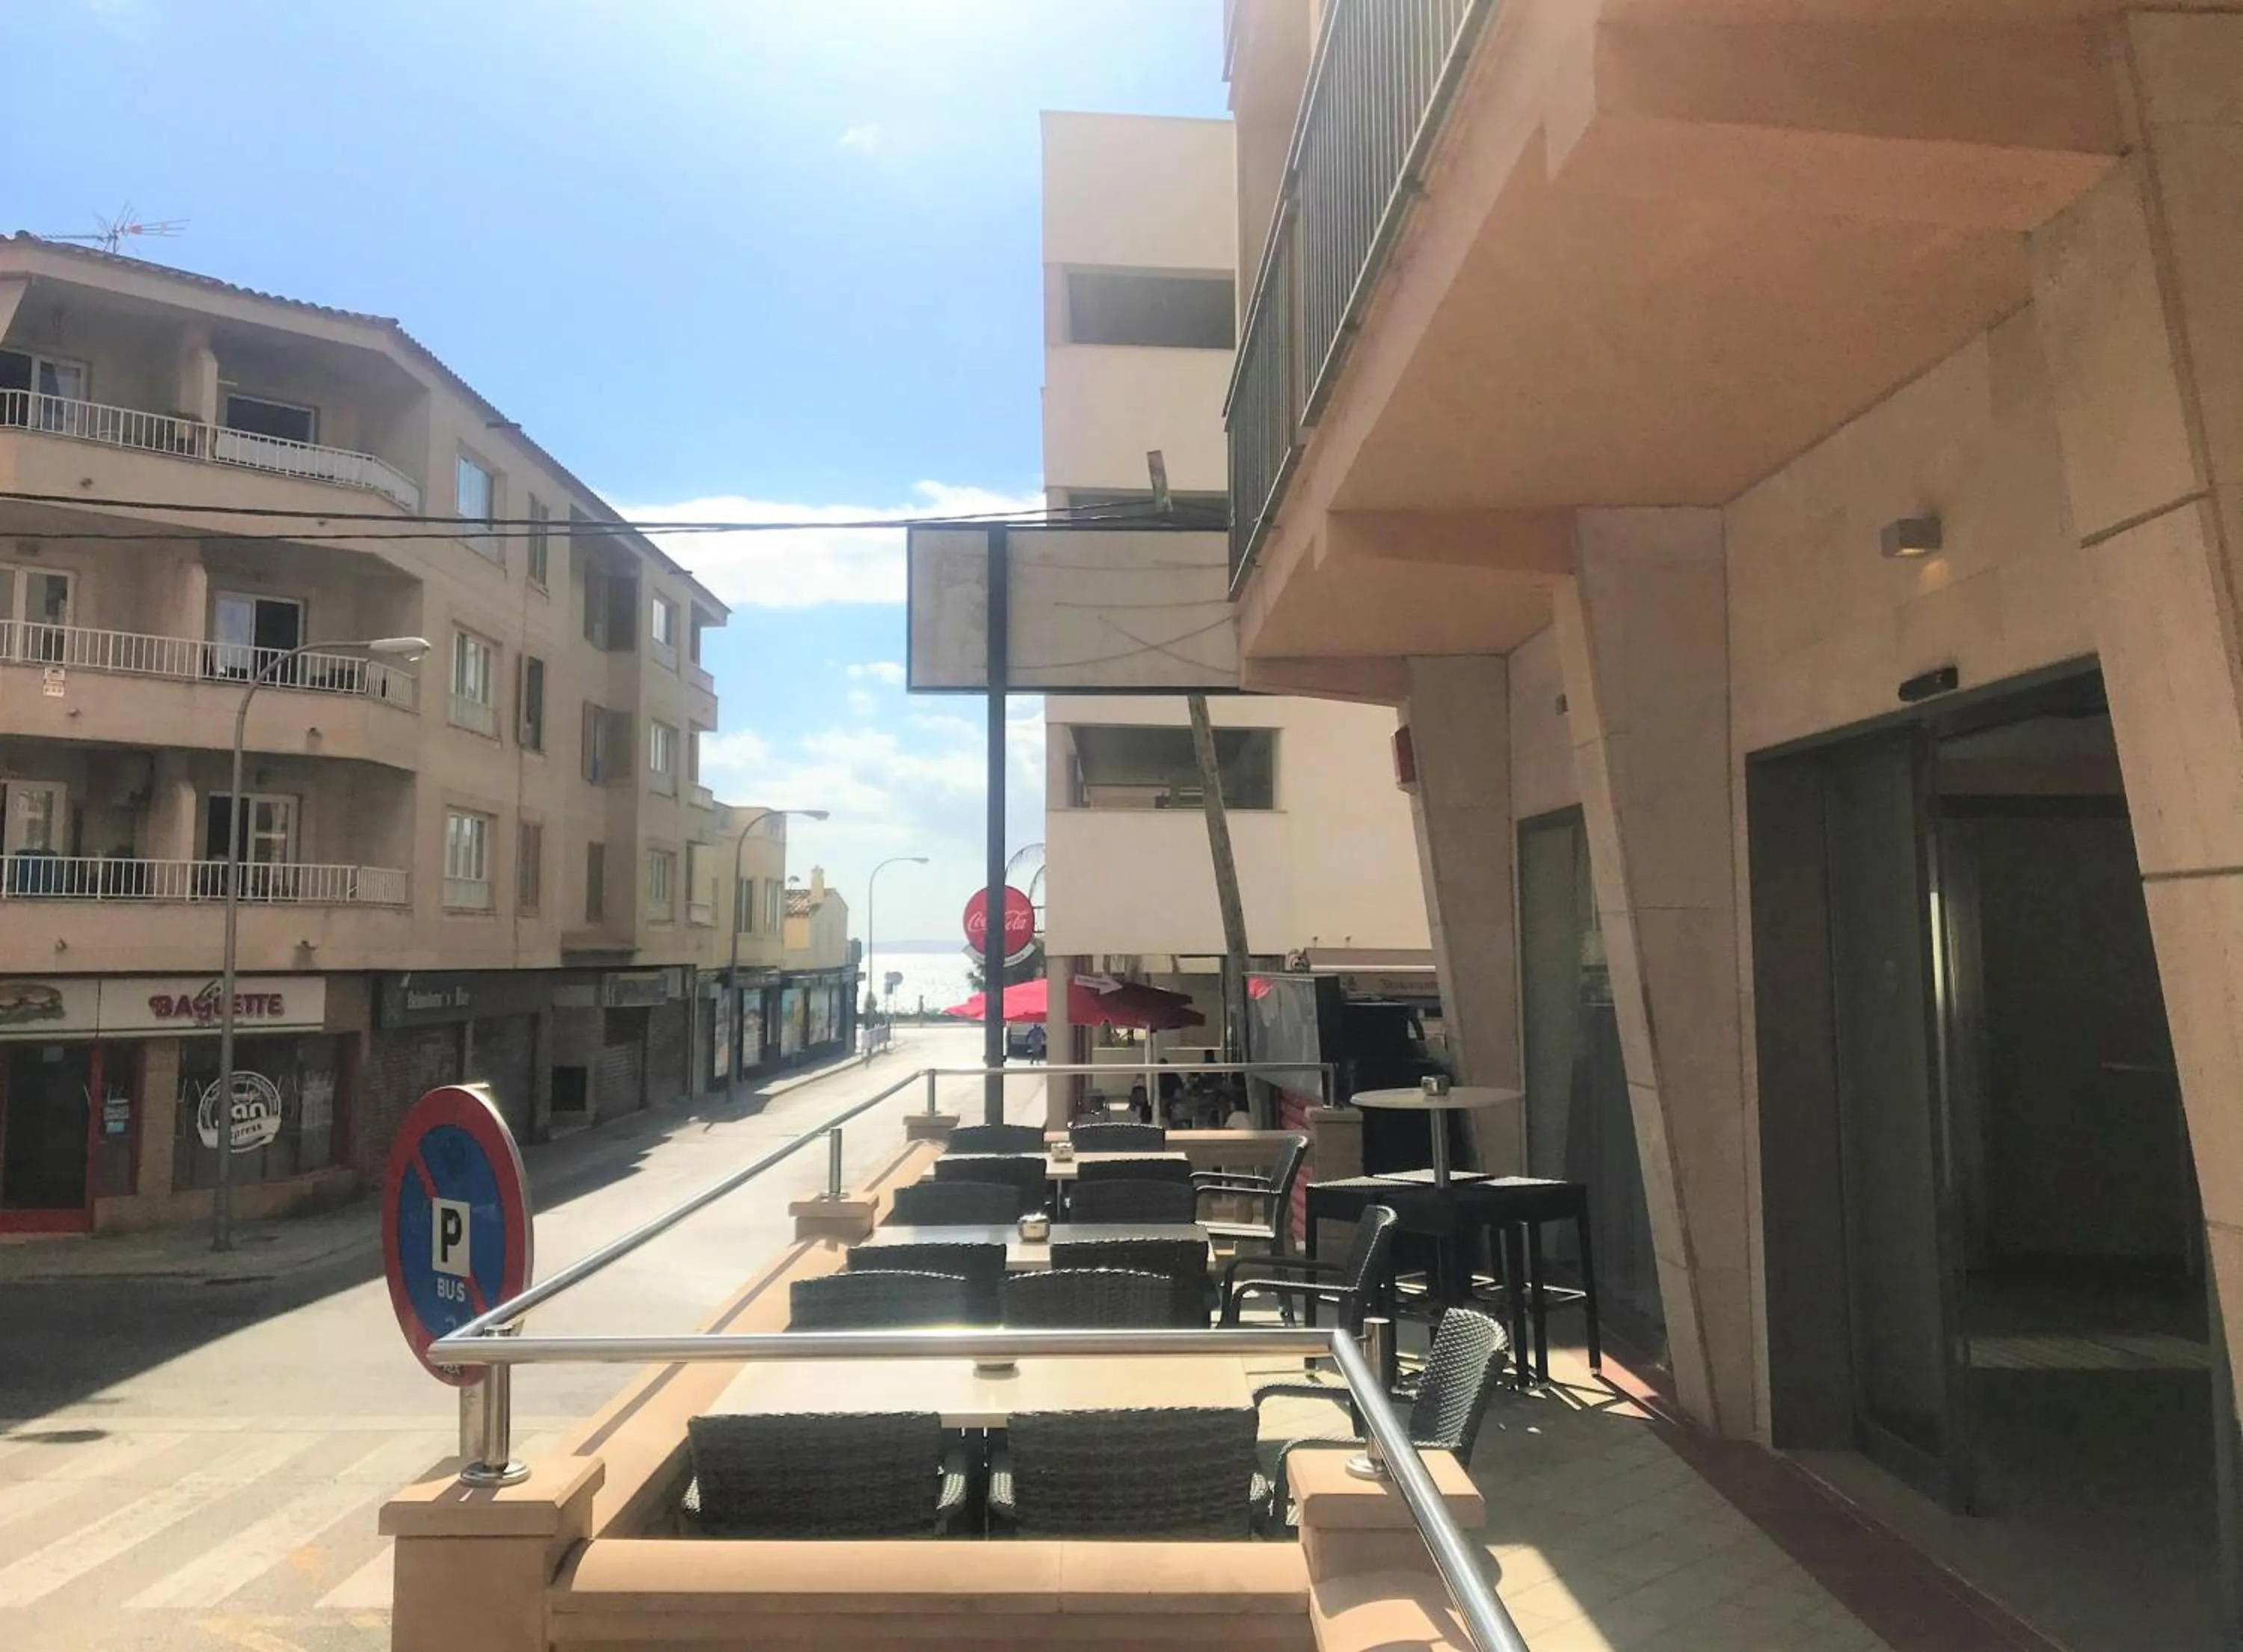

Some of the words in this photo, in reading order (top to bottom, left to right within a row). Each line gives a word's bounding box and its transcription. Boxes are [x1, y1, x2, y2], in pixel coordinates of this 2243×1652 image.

[218, 1103, 266, 1124] an
[231, 1123, 262, 1141] press
[441, 1208, 462, 1263] P
[437, 1277, 465, 1302] BUS
